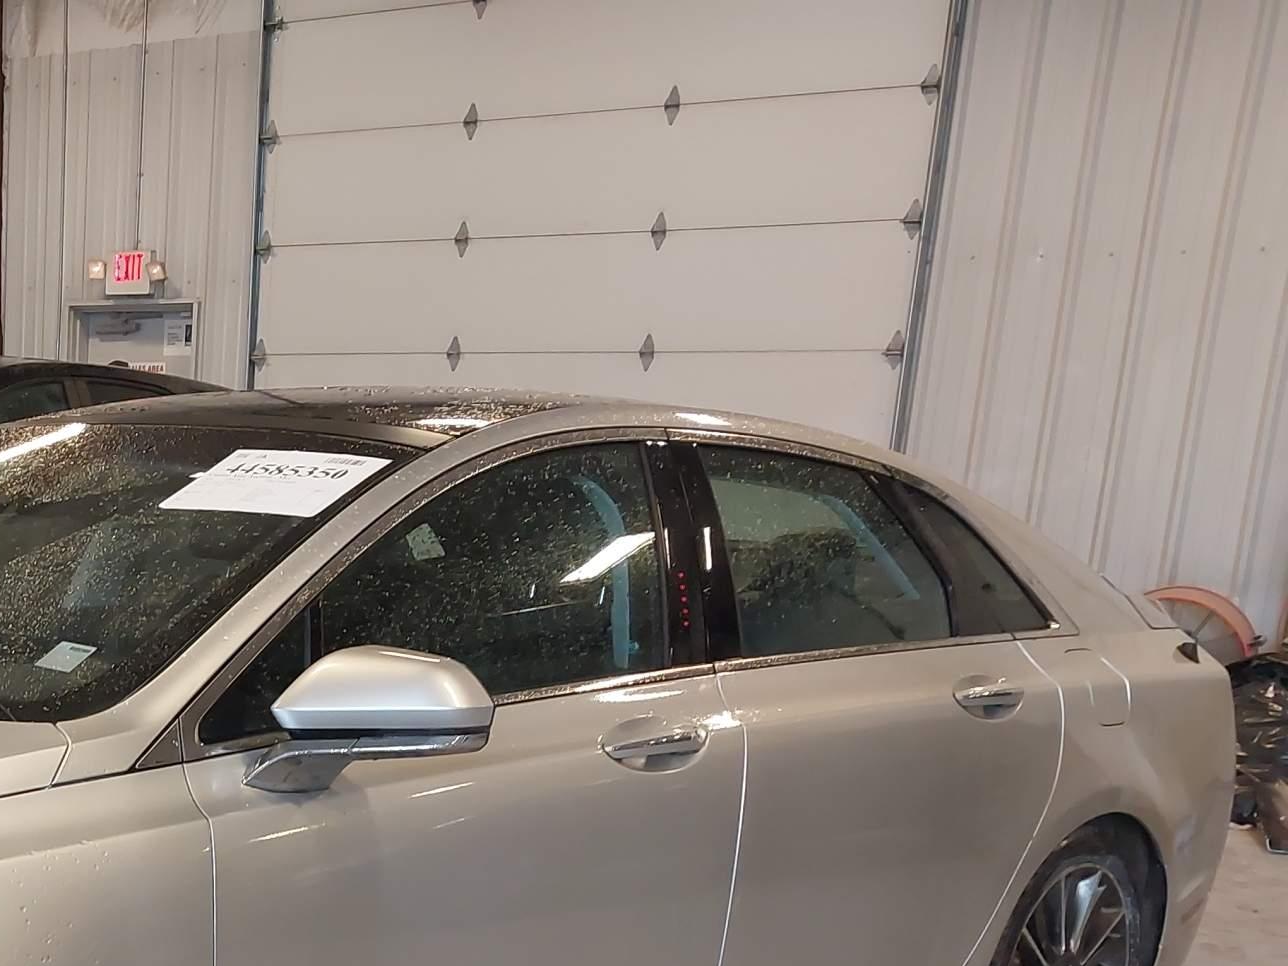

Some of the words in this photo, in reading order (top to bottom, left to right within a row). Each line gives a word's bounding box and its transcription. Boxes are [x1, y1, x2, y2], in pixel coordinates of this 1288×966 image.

[114, 253, 143, 281] EXIT
[148, 364, 164, 373] AREA
[226, 462, 349, 480] 44585350
